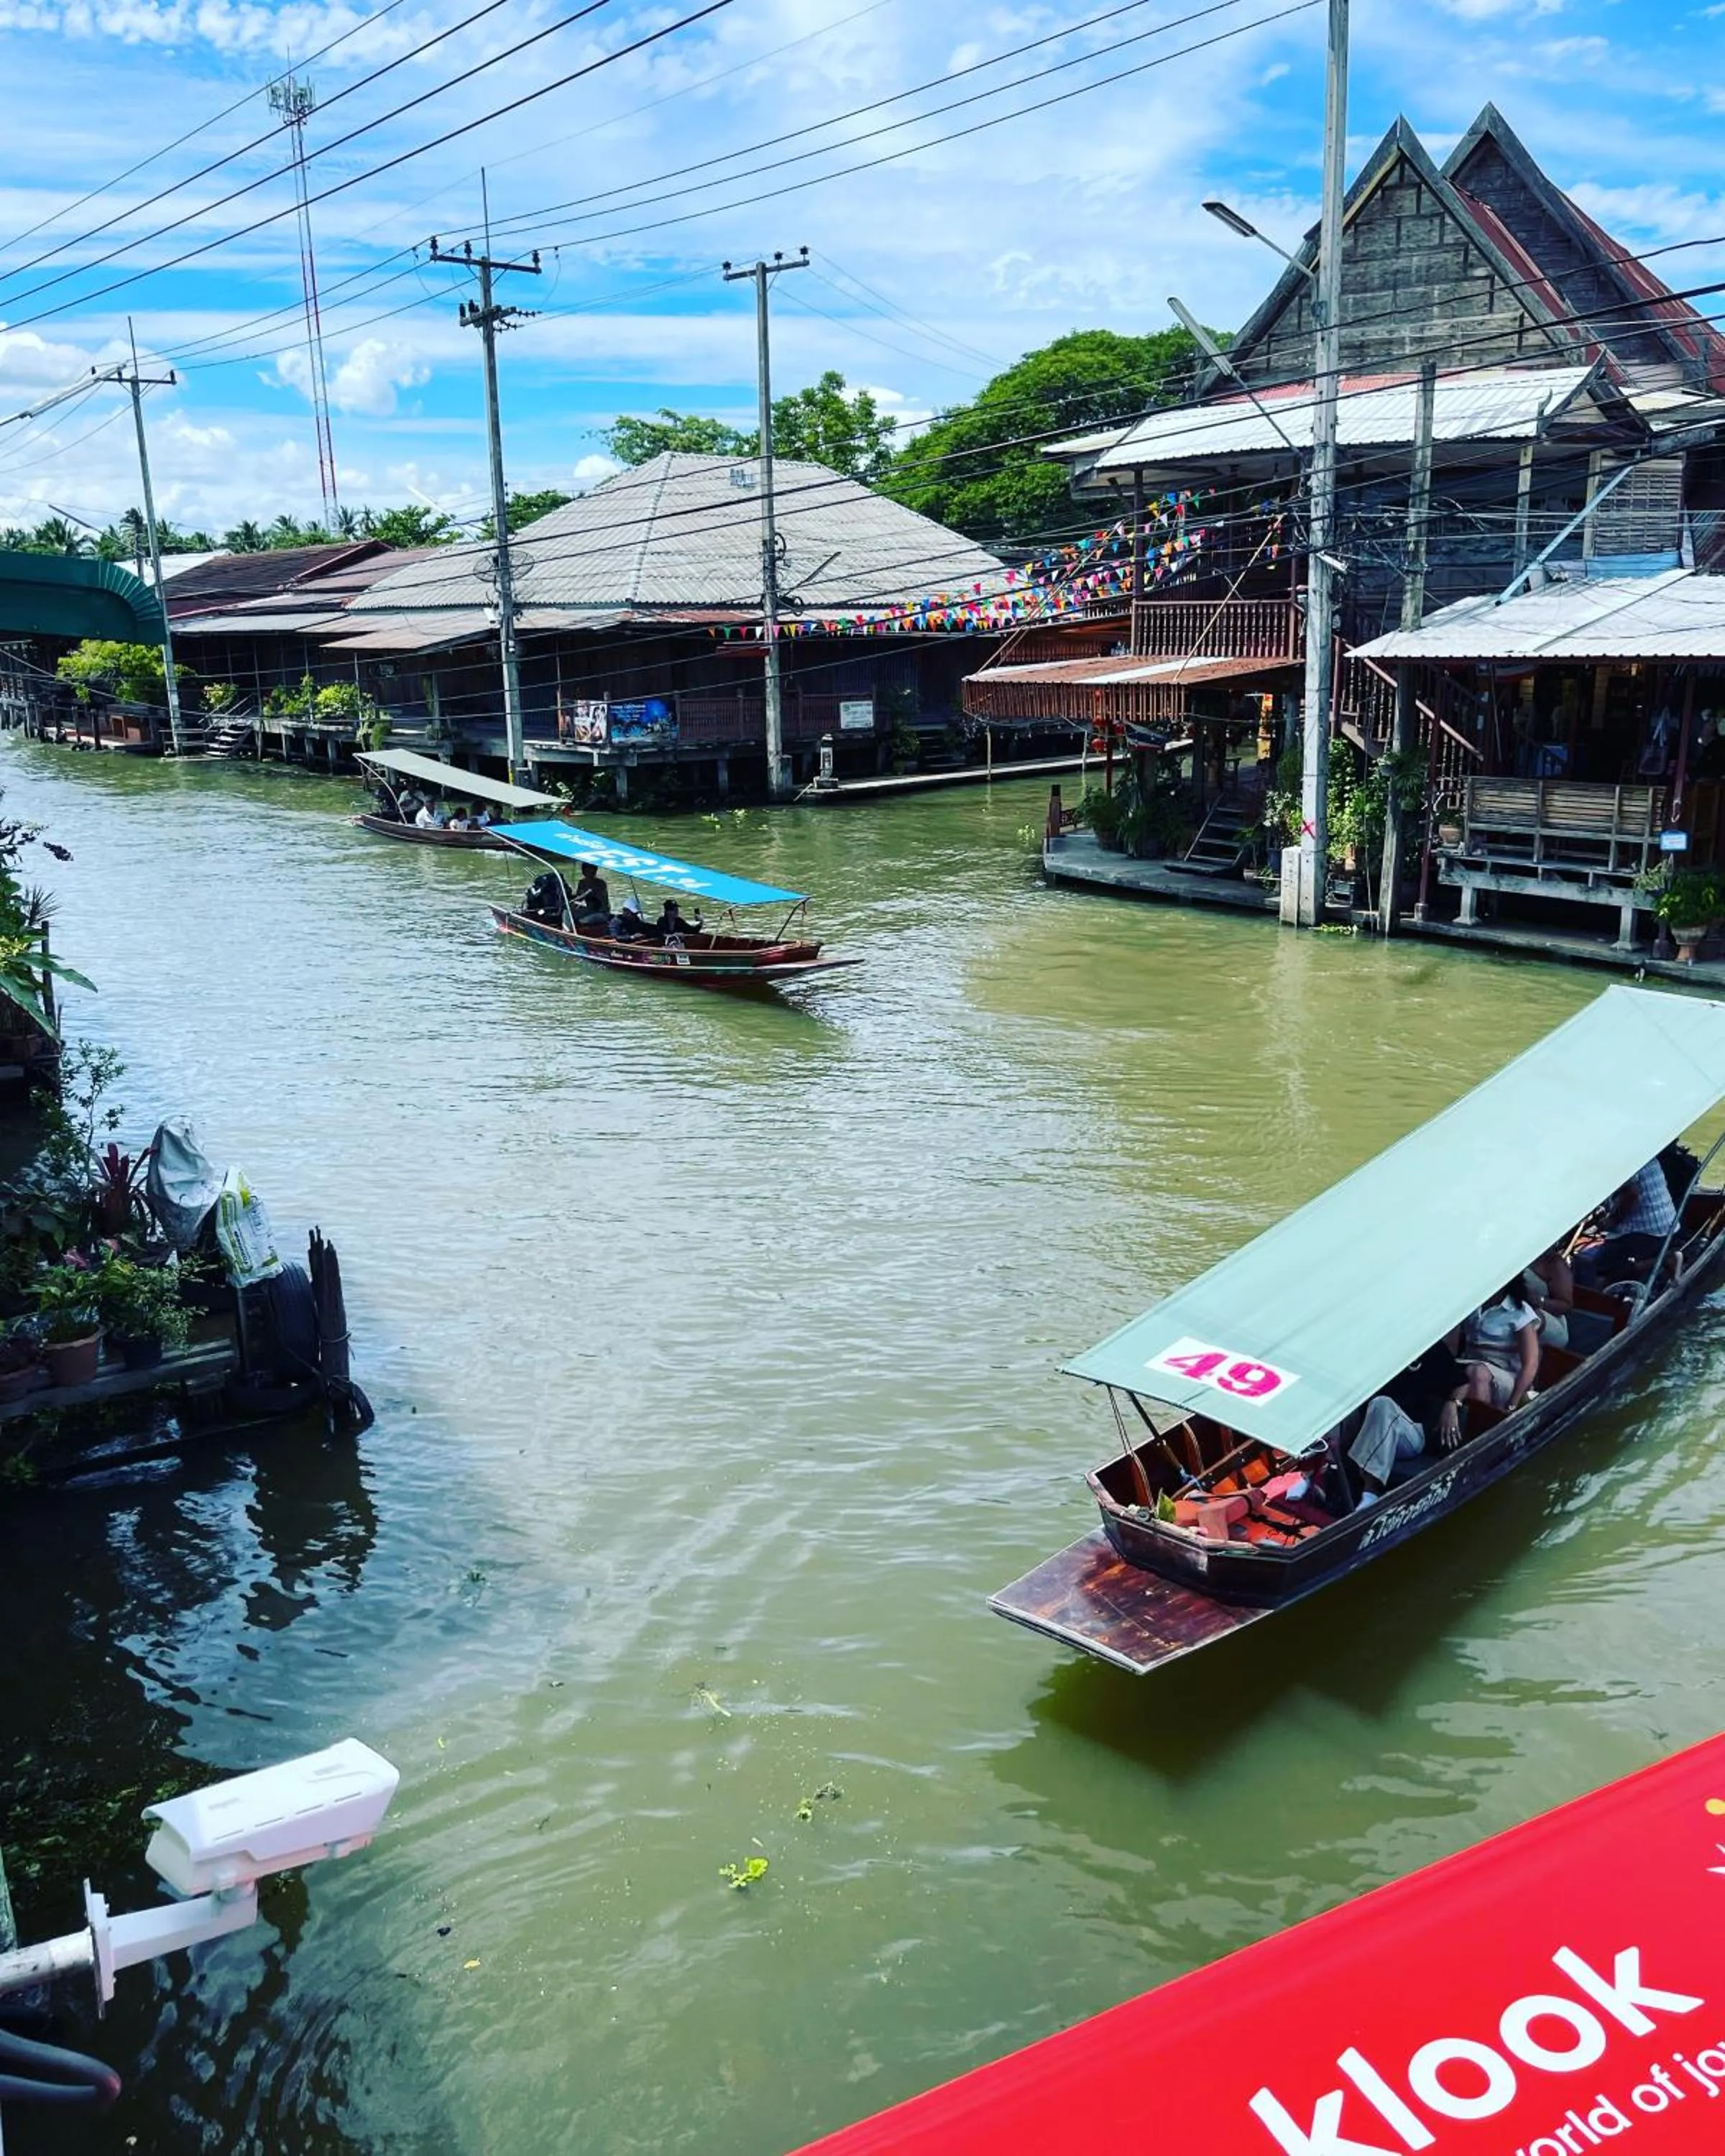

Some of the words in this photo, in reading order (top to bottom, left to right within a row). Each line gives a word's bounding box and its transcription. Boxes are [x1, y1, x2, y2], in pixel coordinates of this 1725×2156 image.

[1163, 1353, 1282, 1398] 49
[1248, 1945, 1705, 2156] klook
[1516, 2093, 1633, 2156] orld
[1632, 2063, 1686, 2113] of
[1673, 2041, 1725, 2098] jo
